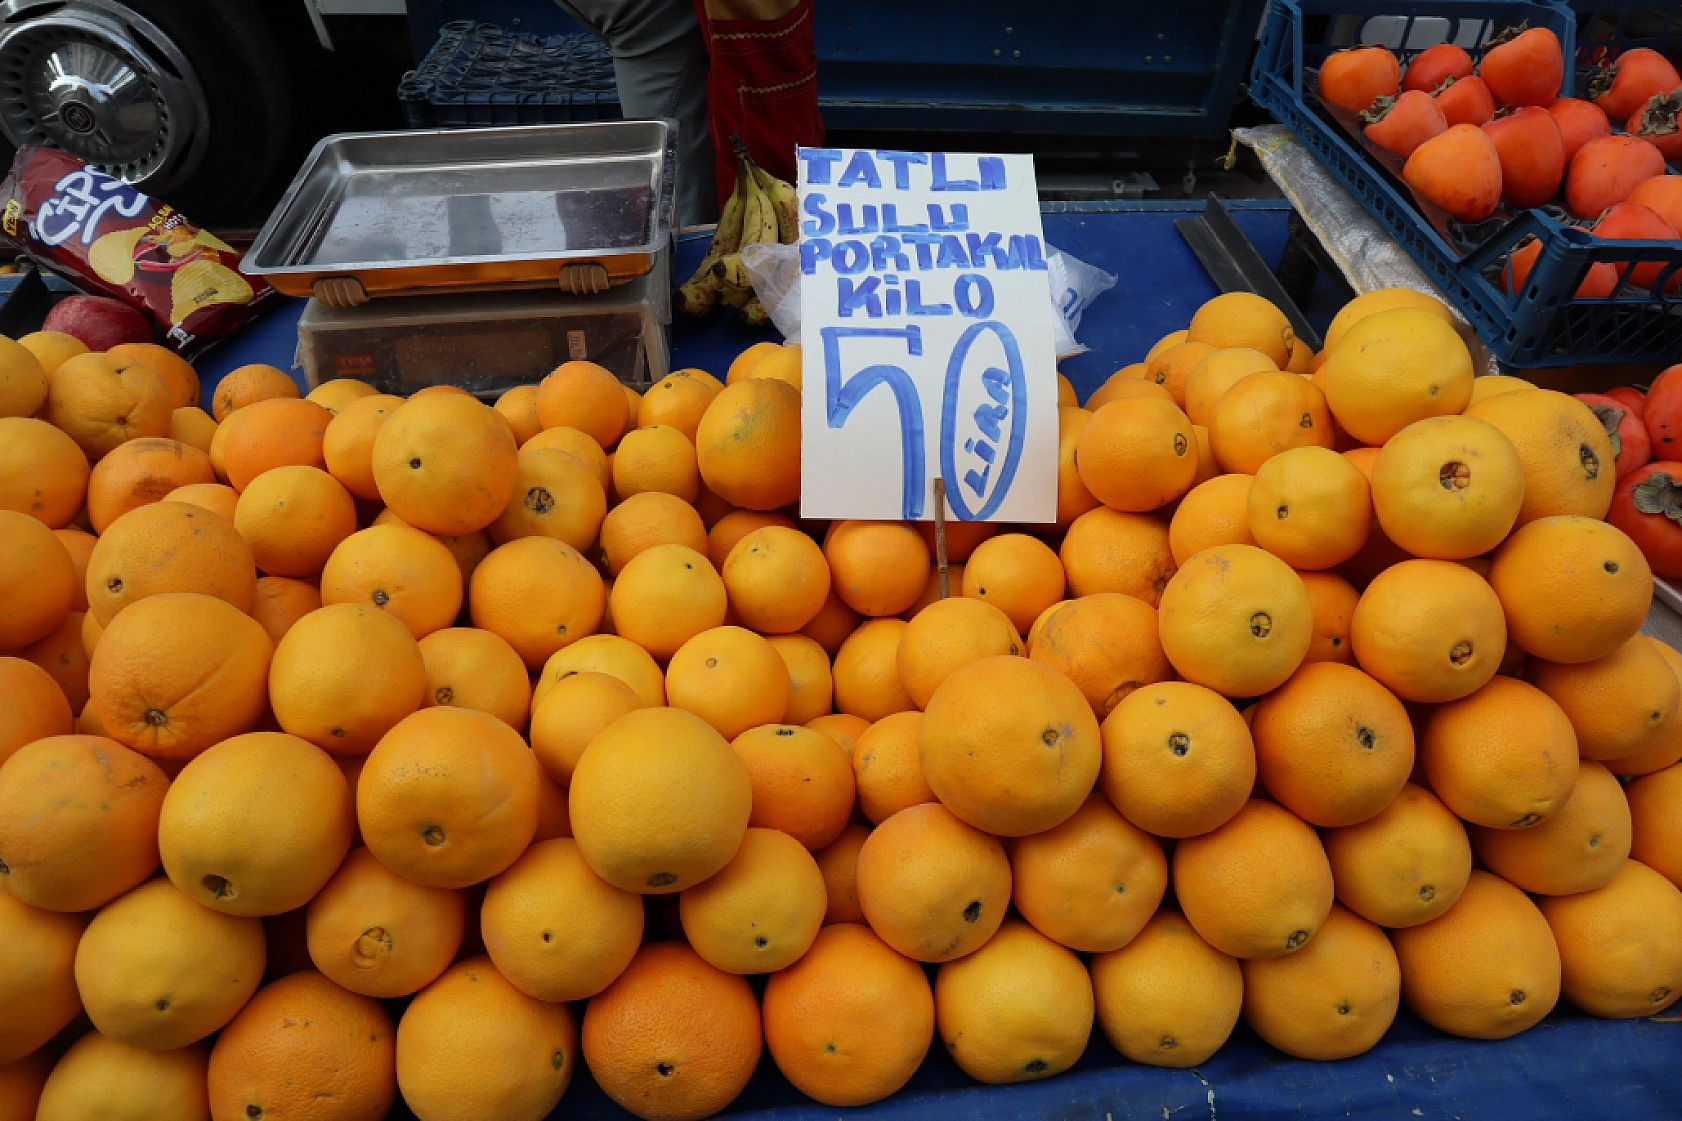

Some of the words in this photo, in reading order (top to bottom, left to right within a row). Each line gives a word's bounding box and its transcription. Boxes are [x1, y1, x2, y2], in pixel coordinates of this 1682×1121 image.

[801, 149, 1007, 191] TATLI
[803, 193, 970, 236] SULU
[800, 232, 1048, 274] PORTAKAL
[837, 273, 995, 318] KiLO
[821, 320, 1028, 522] 50
